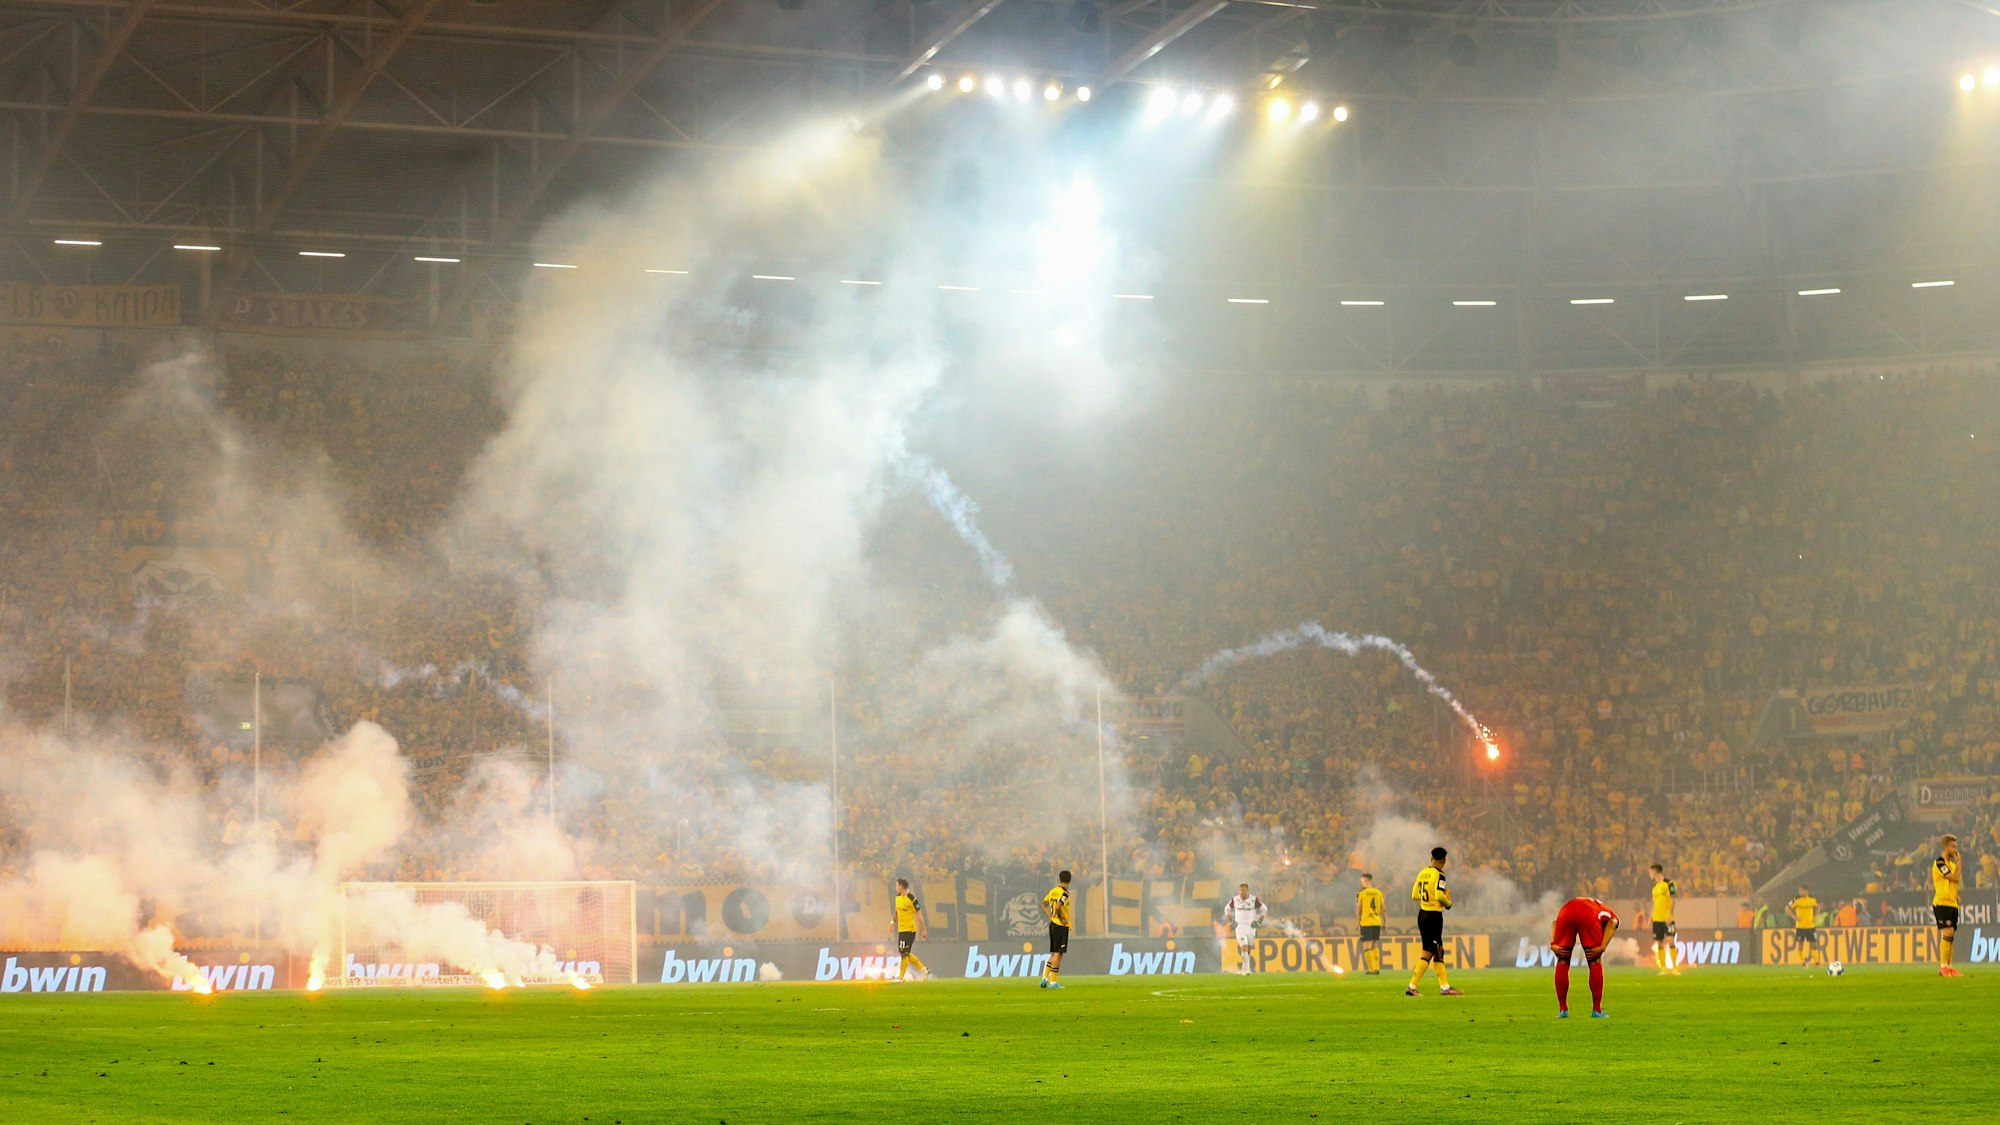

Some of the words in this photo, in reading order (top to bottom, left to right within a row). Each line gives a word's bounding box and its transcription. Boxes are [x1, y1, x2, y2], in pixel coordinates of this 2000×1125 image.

[1370, 897, 1376, 911] 4
[1898, 905, 1990, 925] MITSISHI
[1109, 940, 1196, 975] bwin
[1770, 926, 1941, 963] SPRTWETTEN
[1, 954, 107, 993] bwin
[422, 975, 460, 986] Hotel?
[661, 946, 756, 983] bwin
